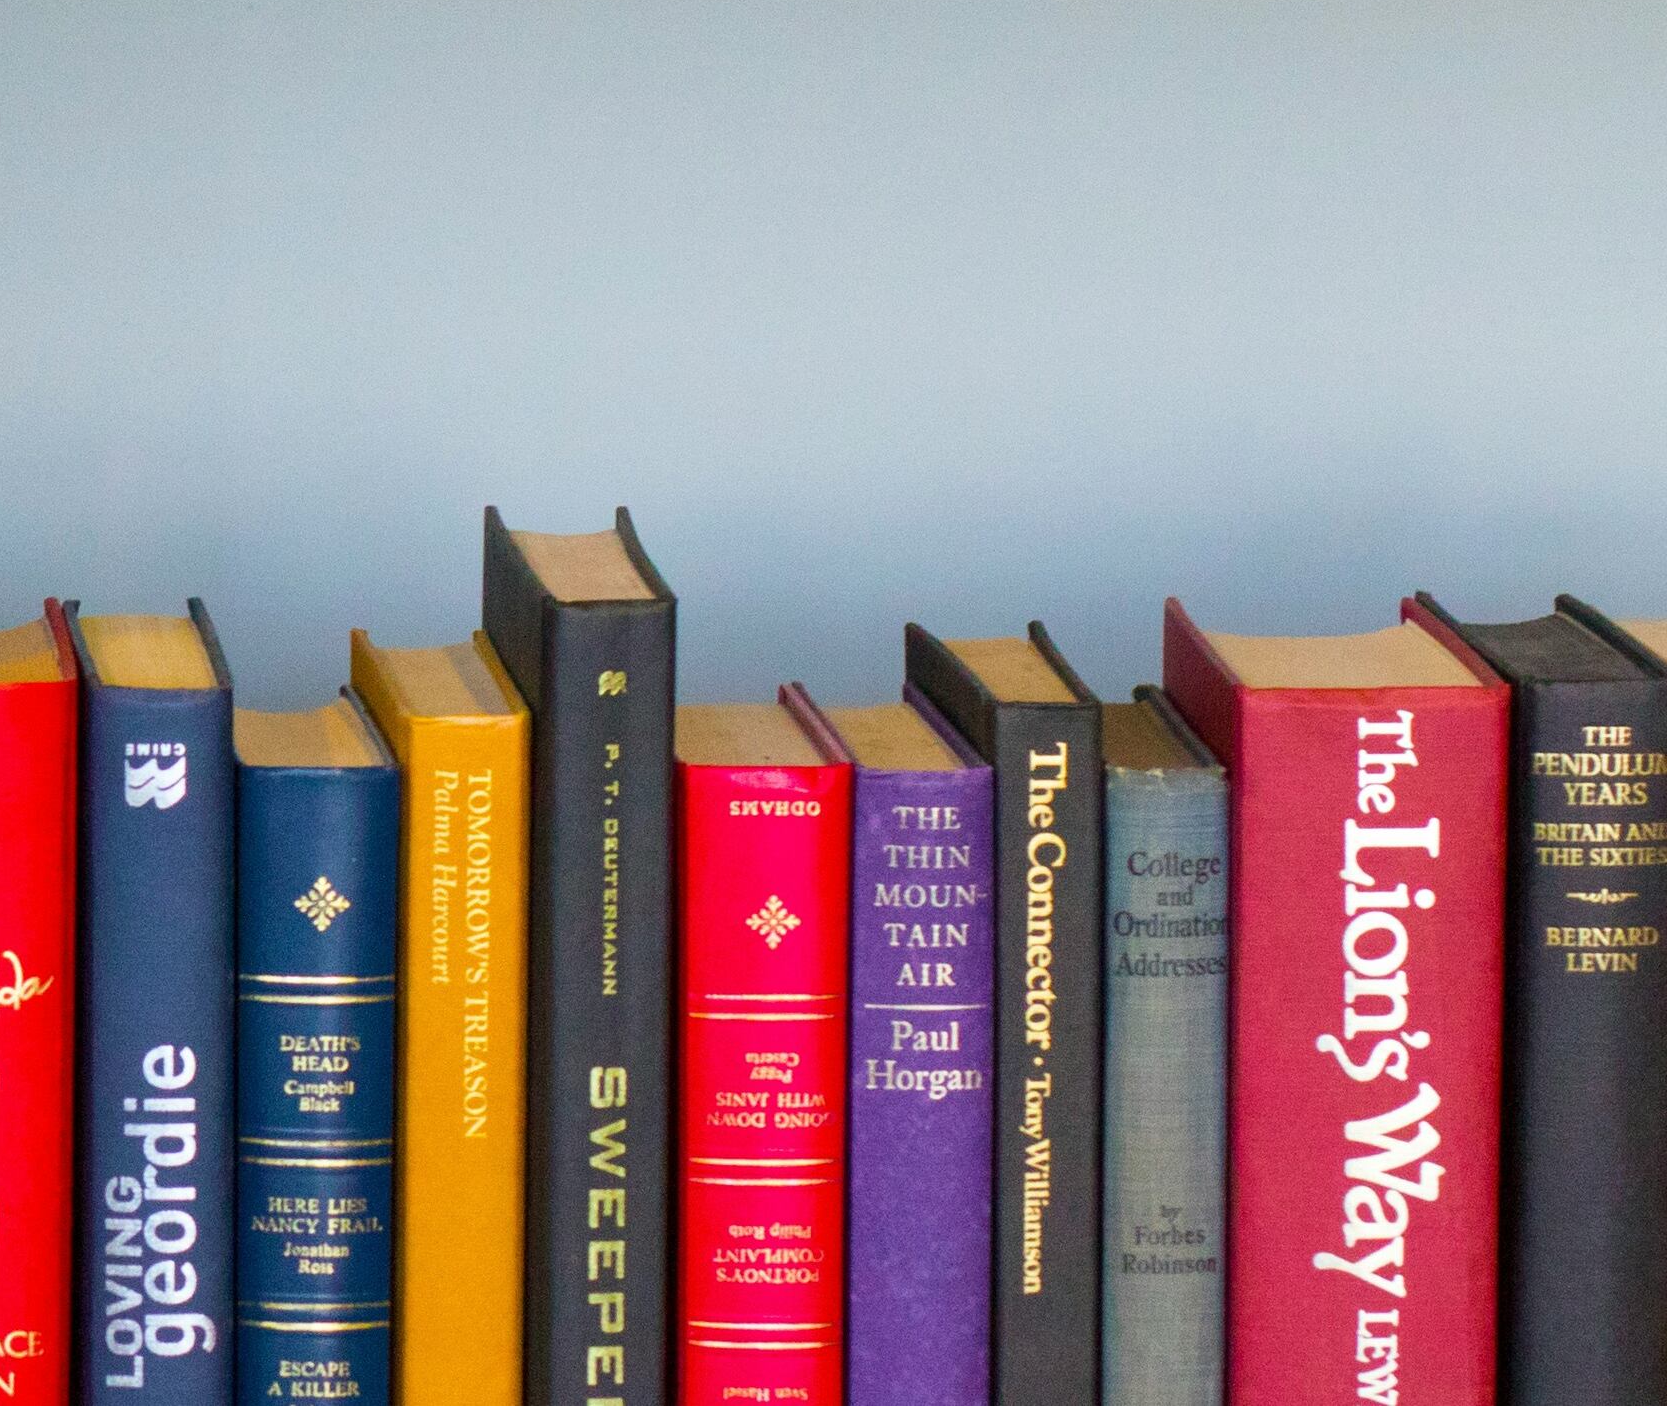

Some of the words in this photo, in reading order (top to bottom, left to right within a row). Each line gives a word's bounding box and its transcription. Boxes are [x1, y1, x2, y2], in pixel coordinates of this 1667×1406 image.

[1357, 710, 1418, 813] The
[1582, 726, 1631, 747] THE
[433, 770, 459, 854] Palma
[892, 806, 960, 830] THE
[1028, 742, 1067, 828] The
[1564, 782, 1647, 806] YEARS
[465, 769, 492, 983] TOMORROW'S
[874, 883, 988, 907] MOUN-
[883, 844, 970, 869] THIN
[432, 864, 457, 984] Harcourt
[602, 819, 619, 995] DEUTERMANN
[884, 923, 968, 948] TAIN
[1025, 832, 1066, 1050] Connector
[1546, 927, 1657, 948] BERNARD
[897, 963, 955, 987] AIR
[1316, 818, 1440, 1082] Lion's
[1567, 952, 1636, 972] LEVIN
[464, 991, 488, 1138] TREASON
[891, 1020, 959, 1051] Paul
[866, 1059, 981, 1101] Horgan
[1021, 1073, 1052, 1137] Tony
[125, 1044, 216, 1356] geordie
[1023, 1139, 1050, 1294] Williamson
[1313, 1082, 1445, 1297] Way
[106, 1175, 143, 1388] LOVING
